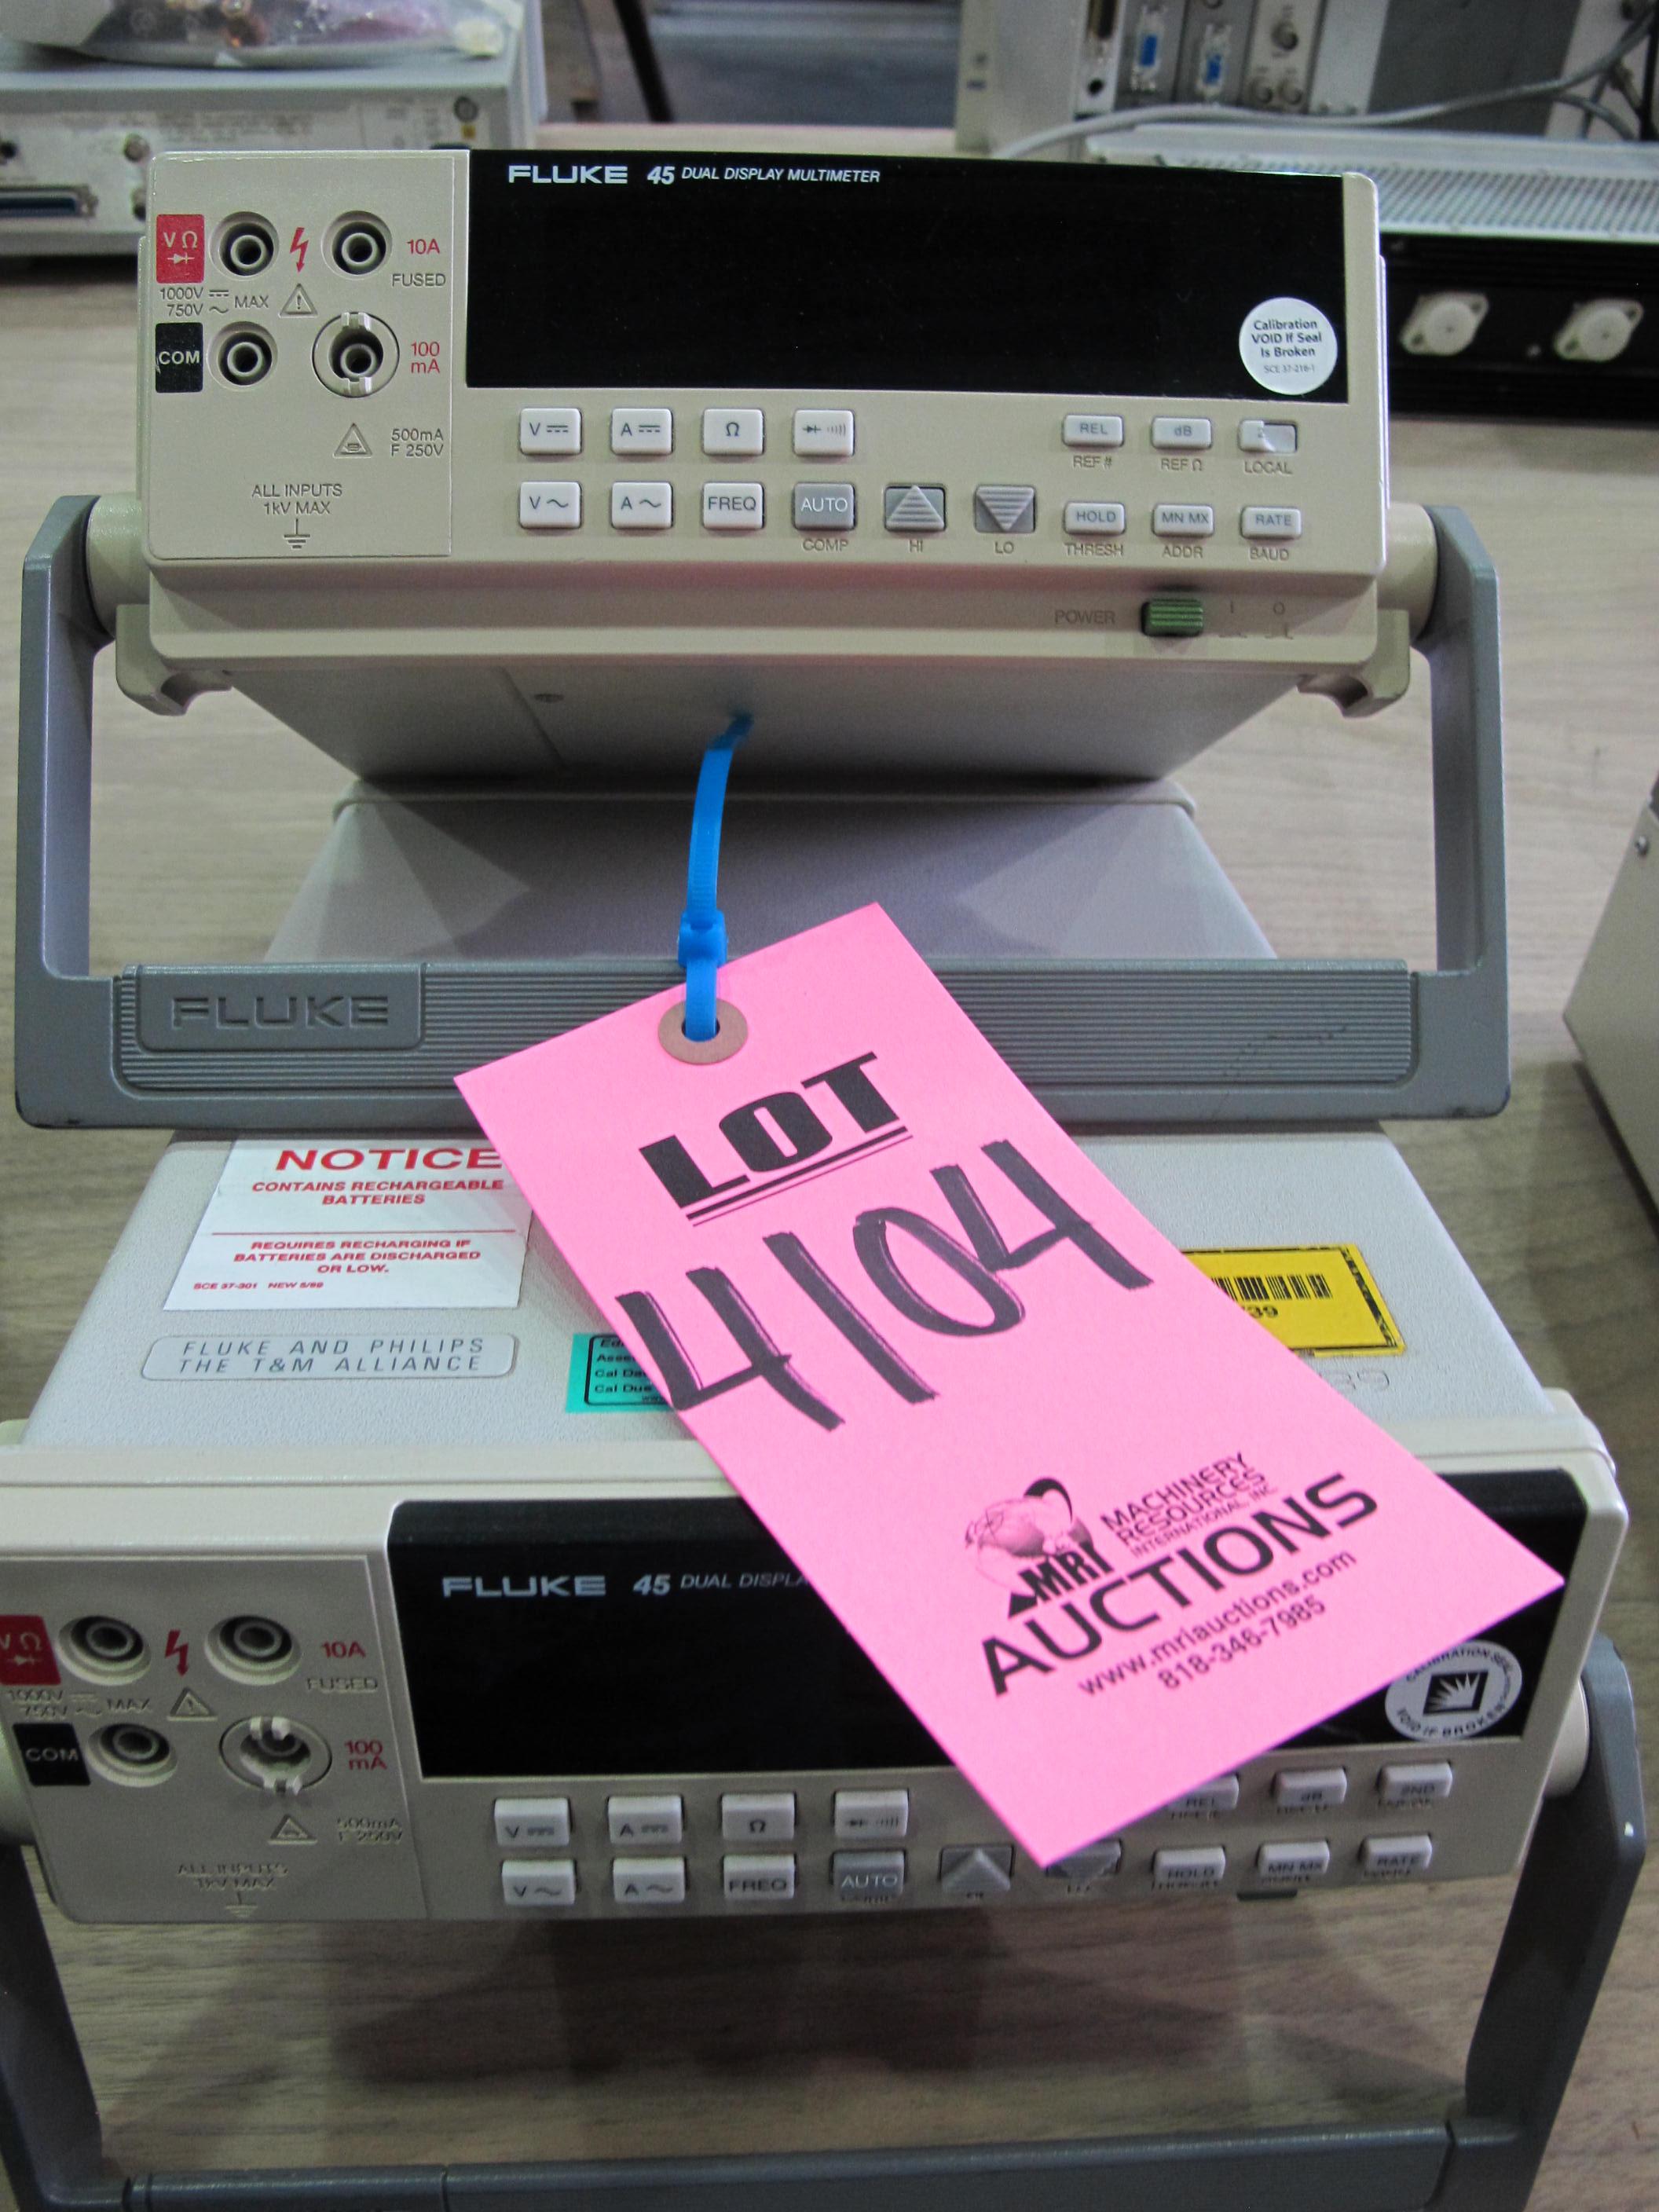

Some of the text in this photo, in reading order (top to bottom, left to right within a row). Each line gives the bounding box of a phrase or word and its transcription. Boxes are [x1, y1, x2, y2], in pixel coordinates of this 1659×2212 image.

[507, 164, 881, 185] FLUKE 45 DUAL DISPLAY MULTIMETER
[406, 238, 441, 255] 10A
[392, 273, 447, 287] FUSED
[159, 287, 203, 301] 1000V
[235, 295, 269, 309] MAX
[167, 303, 203, 317] 750V
[1254, 318, 1317, 331] Calibration
[1251, 331, 1322, 344] VOID If Seal
[410, 342, 440, 357] 100
[1261, 346, 1316, 358] Is Broken
[159, 351, 200, 366] COM
[410, 361, 440, 374] mA
[391, 428, 444, 441] 500mA
[1080, 423, 1108, 434] REL
[1174, 426, 1192, 438] dB
[391, 444, 444, 457] F 250V
[1073, 456, 1101, 468] REF
[1161, 459, 1187, 471] REF
[1244, 461, 1293, 475] LOCAL
[251, 484, 343, 498] ALL INPUTS
[264, 501, 331, 515] 1kV MAX
[709, 496, 756, 511] FREQ
[801, 496, 848, 512] AUTO
[1076, 511, 1116, 523] HOLD
[1162, 511, 1208, 524] MN MX
[1255, 515, 1292, 526] RATE
[802, 539, 850, 551] COMP
[909, 540, 923, 552] HI
[994, 542, 1014, 555] LO
[1064, 543, 1124, 557] THRESH
[1162, 546, 1203, 558] ADDR
[1250, 548, 1290, 561] BAUD
[1054, 610, 1116, 625] POWER
[172, 996, 389, 1028] FLUKE
[639, 1051, 901, 1210] LOT
[275, 1148, 503, 1171] NOTICE
[252, 1180, 504, 1192] CONTAINS RECHARGEABLE
[321, 1194, 426, 1206] BATTERIES
[251, 1240, 471, 1251] REQUIRES RECHARGING IF
[233, 1251, 482, 1262] BATTERIES ARE DISCHARGED
[317, 1264, 390, 1274] OR LOW.
[615, 1139, 1154, 1432] 4104
[182, 1339, 485, 1357] FLUKE AND PHILIPS
[179, 1357, 482, 1373] THE T&M ALLIANCE
[1101, 1452, 1250, 1531] MACHINERY
[1115, 1468, 1265, 1546] RESOURCES
[442, 1576, 606, 1598] FLUKE
[632, 1574, 672, 1596] 45
[680, 1573, 732, 1590] DUAL
[982, 1473, 1378, 1696] AUCTIONS
[1079, 1551, 1357, 1696] www.mriauctions.com
[320, 1641, 367, 1658] 10A
[1158, 1595, 1326, 1691] 818-346-7985
[306, 1677, 379, 1691] FUSED
[345, 1739, 383, 1755] 100
[26, 1748, 79, 1763] COM
[348, 1756, 387, 1771] mA
[729, 1877, 788, 1893] FREQ
[841, 1873, 898, 1889] AUTO
